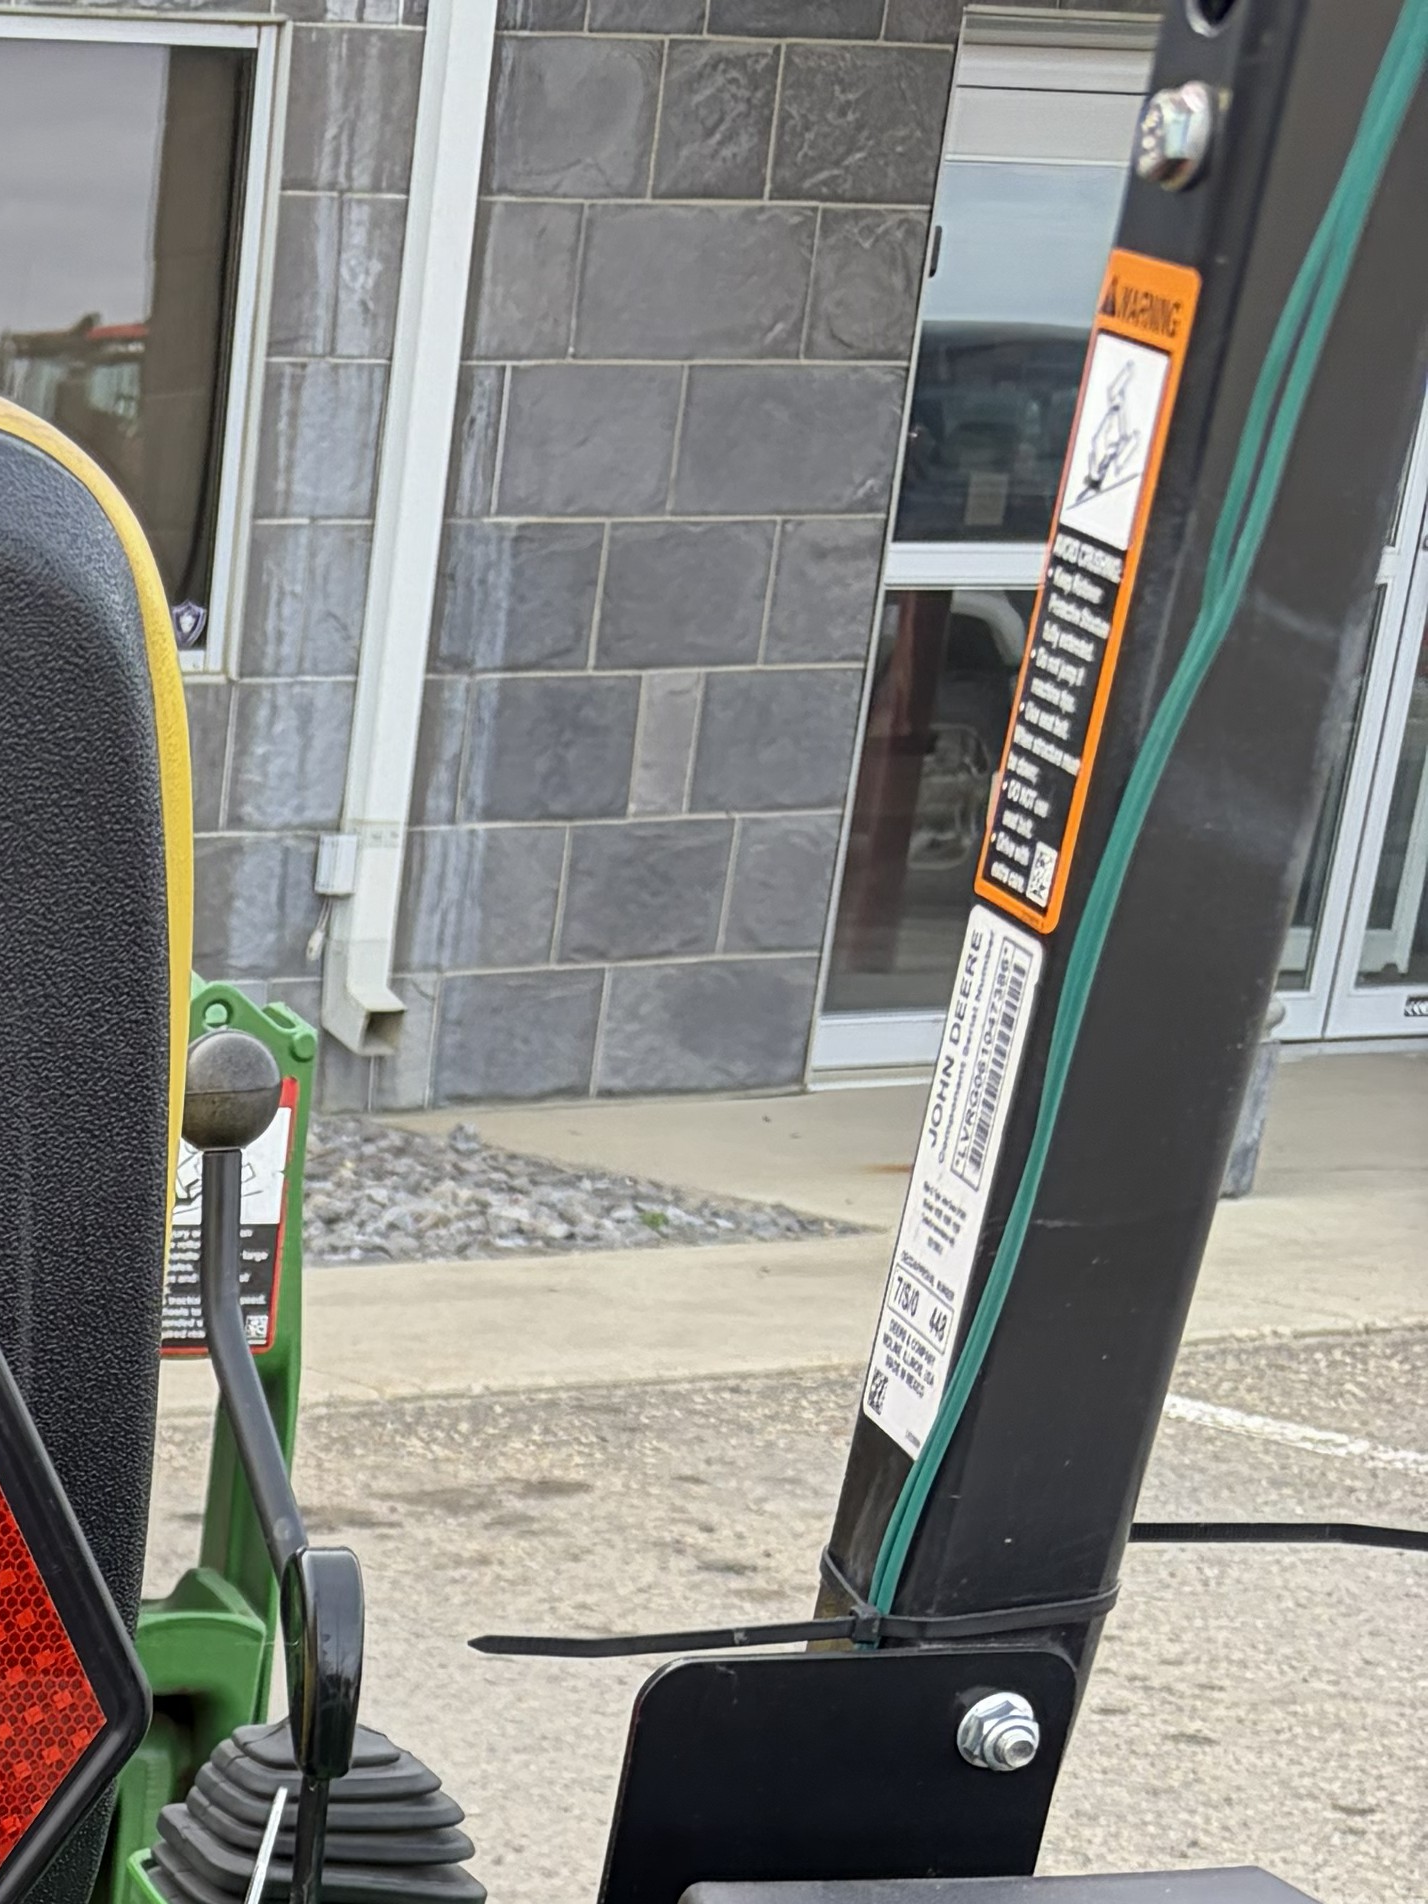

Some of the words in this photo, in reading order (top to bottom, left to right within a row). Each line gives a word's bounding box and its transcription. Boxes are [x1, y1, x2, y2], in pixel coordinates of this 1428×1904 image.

[926, 1055, 956, 1147] JOHN
[949, 930, 983, 1045] DEERE
[938, 1061, 966, 1164] Component
[975, 931, 995, 1001] Number
